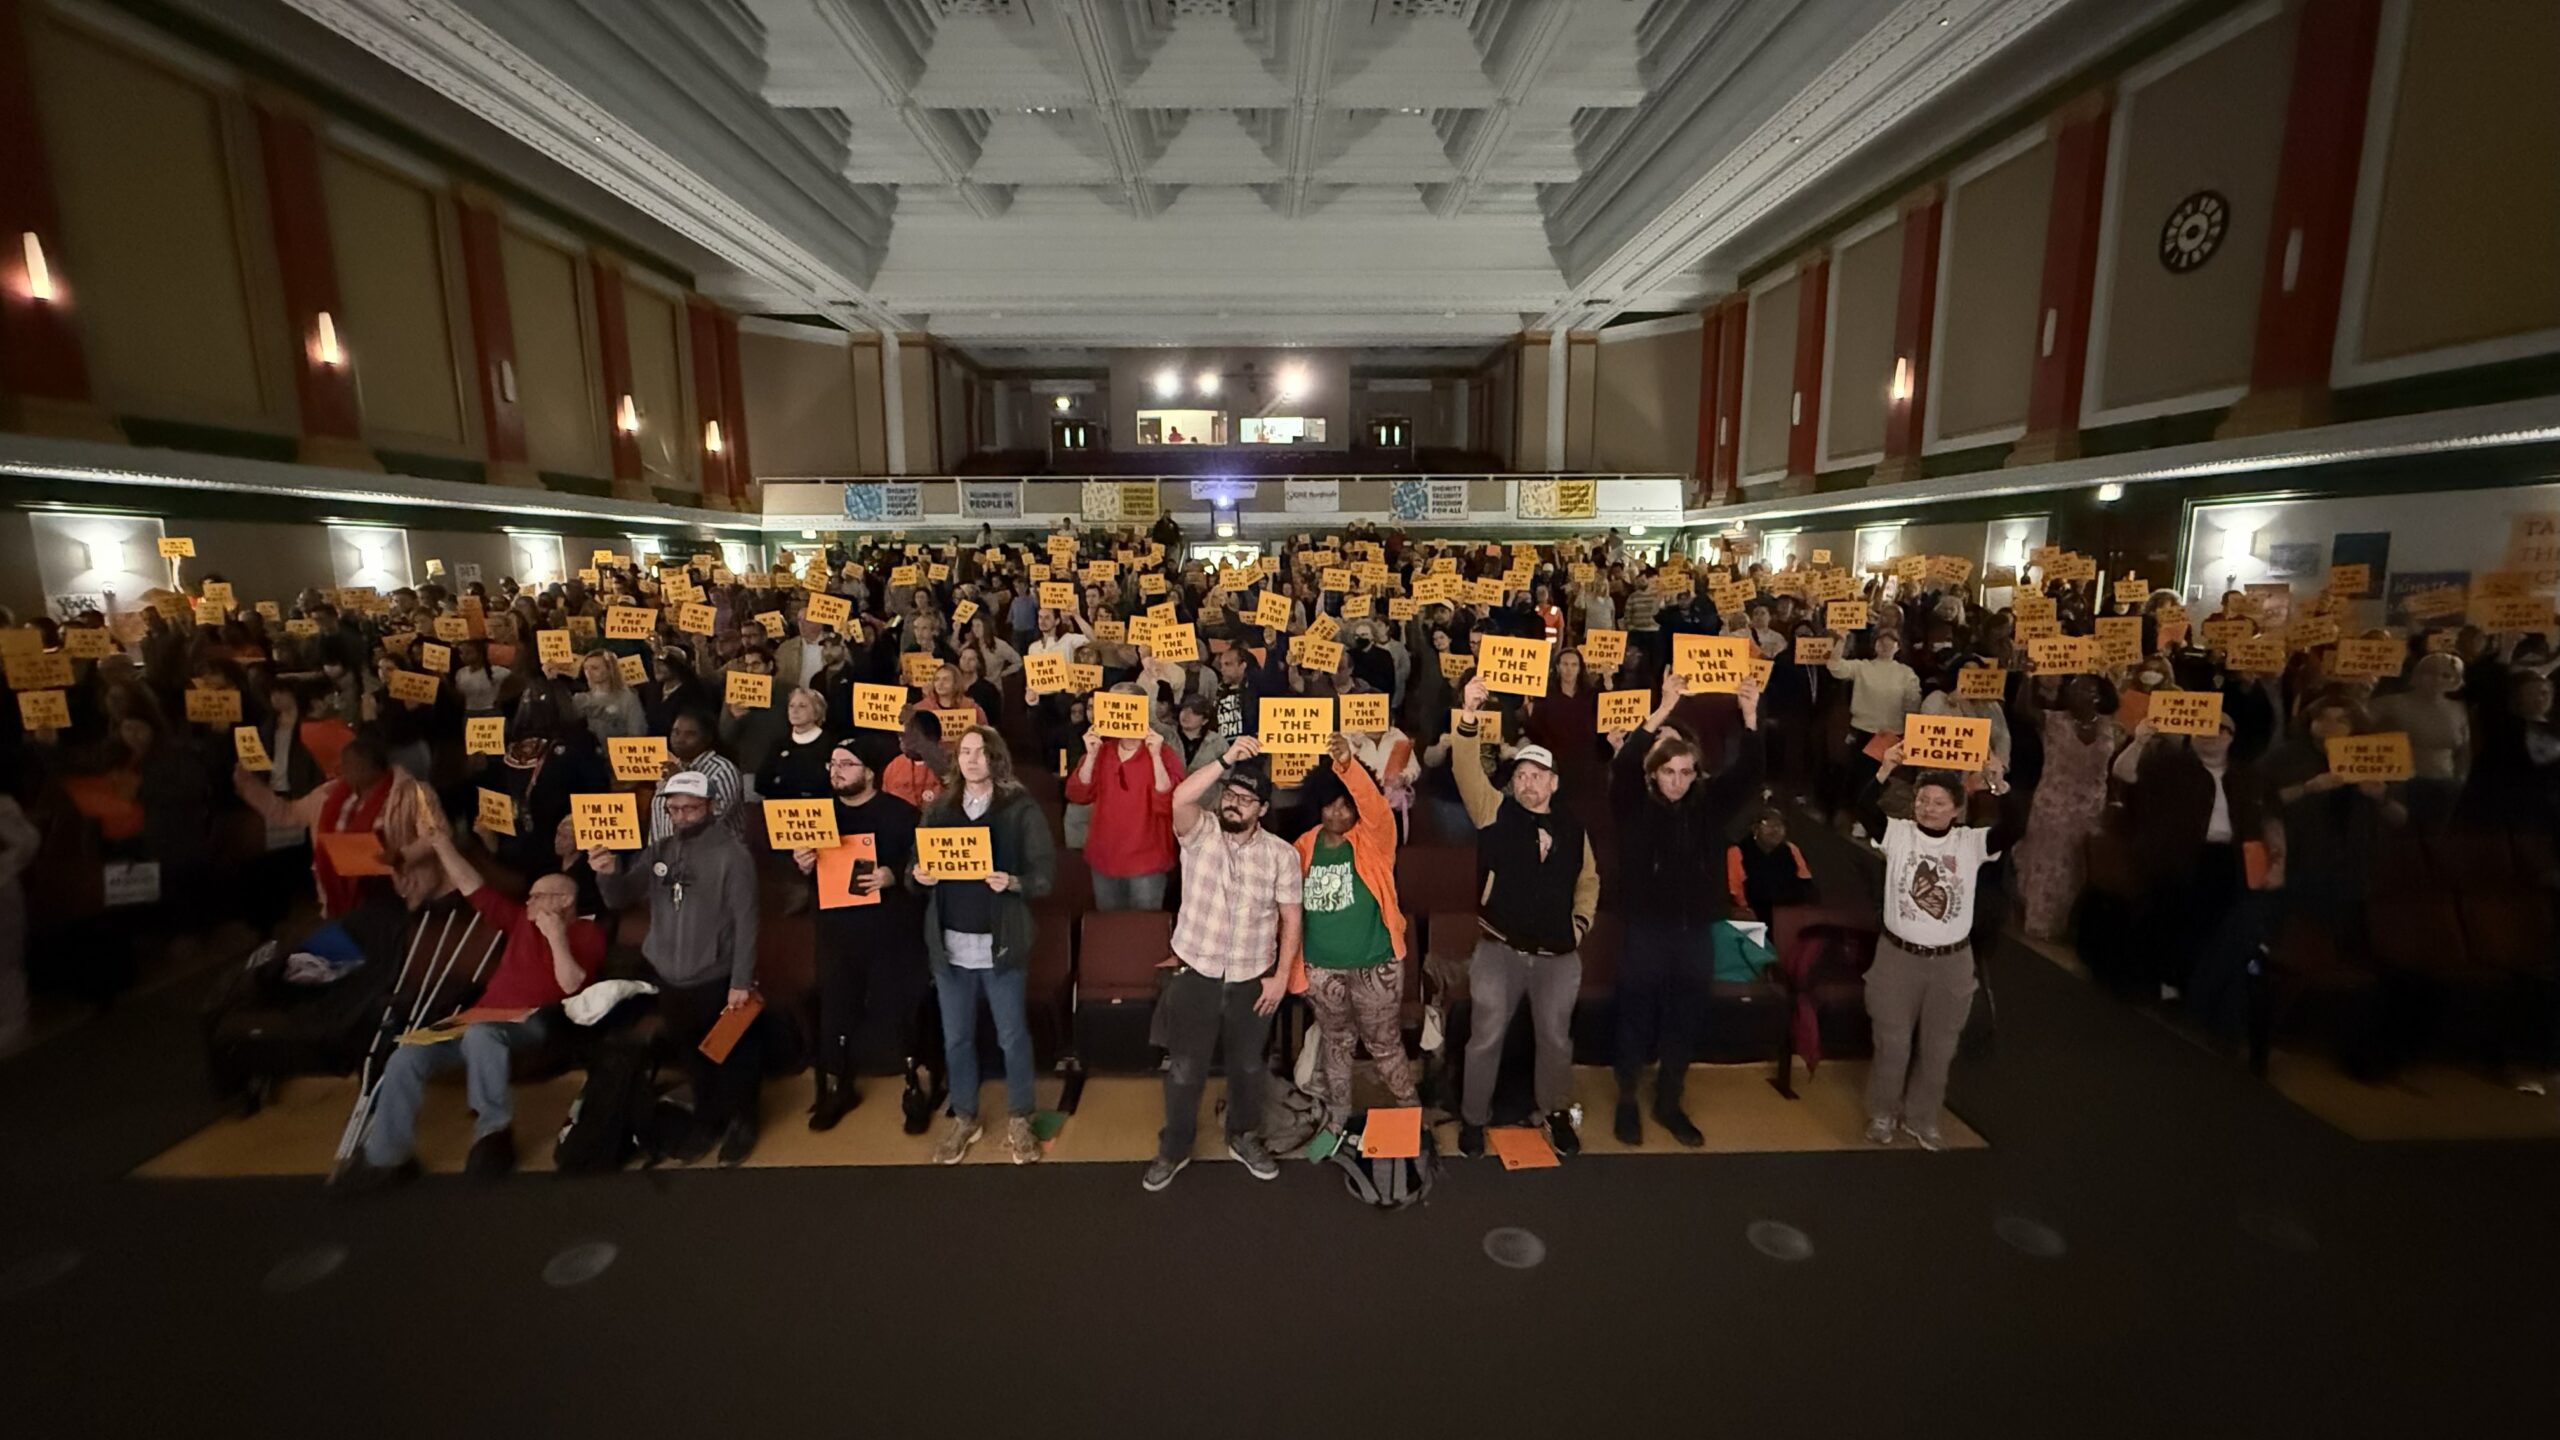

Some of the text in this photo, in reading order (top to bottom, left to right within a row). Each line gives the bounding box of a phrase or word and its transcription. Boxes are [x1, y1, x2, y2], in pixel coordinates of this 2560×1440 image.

[970, 500, 1013, 508] PEOPLE IN
[1265, 598, 1276, 606] I'M
[820, 605, 837, 613] THE
[1268, 606, 1281, 616] THE
[689, 614, 704, 622] THE
[810, 610, 844, 621] FIGHT!
[1259, 612, 1285, 624] FIGHT!
[682, 619, 710, 630] FIGHT!
[1158, 630, 1186, 640] I'M IN
[1162, 639, 1182, 648] THE
[1597, 642, 1614, 650] THE
[1155, 647, 1194, 658] FIGHT!
[1491, 645, 1536, 659] I'M IN
[1587, 649, 1621, 658] FIGHT!
[1687, 648, 1733, 659] I'M IN
[2045, 652, 2069, 660] THE
[1030, 658, 1057, 668] I'M IN
[1497, 658, 1527, 671] THE
[1696, 659, 1728, 670] THE
[1036, 667, 1054, 675] THE
[733, 677, 748, 685] I'M
[1030, 674, 1064, 686] FIGHT!
[1482, 668, 1541, 687] FIGHT!
[1971, 679, 1991, 687] THE
[738, 685, 757, 694] THE
[729, 691, 767, 701] FIGHT!
[862, 691, 896, 702] I'M IN
[1606, 696, 1640, 706] I'M IN
[867, 701, 889, 712] THE
[1103, 700, 1138, 711] I'M IN
[1348, 700, 1364, 708] I'M
[2162, 698, 2208, 707] I'M IN
[1108, 710, 1132, 720] THE
[1273, 707, 1319, 717] I'M IN
[1611, 706, 1633, 714] THE
[2169, 707, 2198, 717] THE
[858, 711, 896, 723] FIGHT
[1344, 717, 1384, 726] FIGHT!
[2152, 716, 2214, 728] FIGHT!
[1098, 719, 1143, 731] FIGHT!
[1279, 720, 1311, 730] THE
[1920, 724, 1974, 737] I'M IN
[1265, 732, 1326, 744] FIGHT!
[1927, 737, 1963, 748] THE
[468, 740, 501, 748] FIGHT!
[618, 745, 656, 753] I'M IN
[2343, 744, 2394, 754] I'M IN
[625, 755, 650, 764] THE
[1910, 747, 1979, 762] FIGHT!
[2351, 753, 2386, 764] THE
[2336, 763, 2402, 773] FIGHT!
[582, 803, 623, 814] I'M IN
[777, 808, 821, 818] I'M IN
[589, 816, 618, 827] THE
[786, 820, 816, 829] THE
[579, 828, 633, 840] FIGHT!
[775, 830, 833, 841] FIGHT!
[930, 836, 977, 847] I'M IN
[938, 849, 970, 858] THE
[926, 860, 986, 871] FIGHT!
